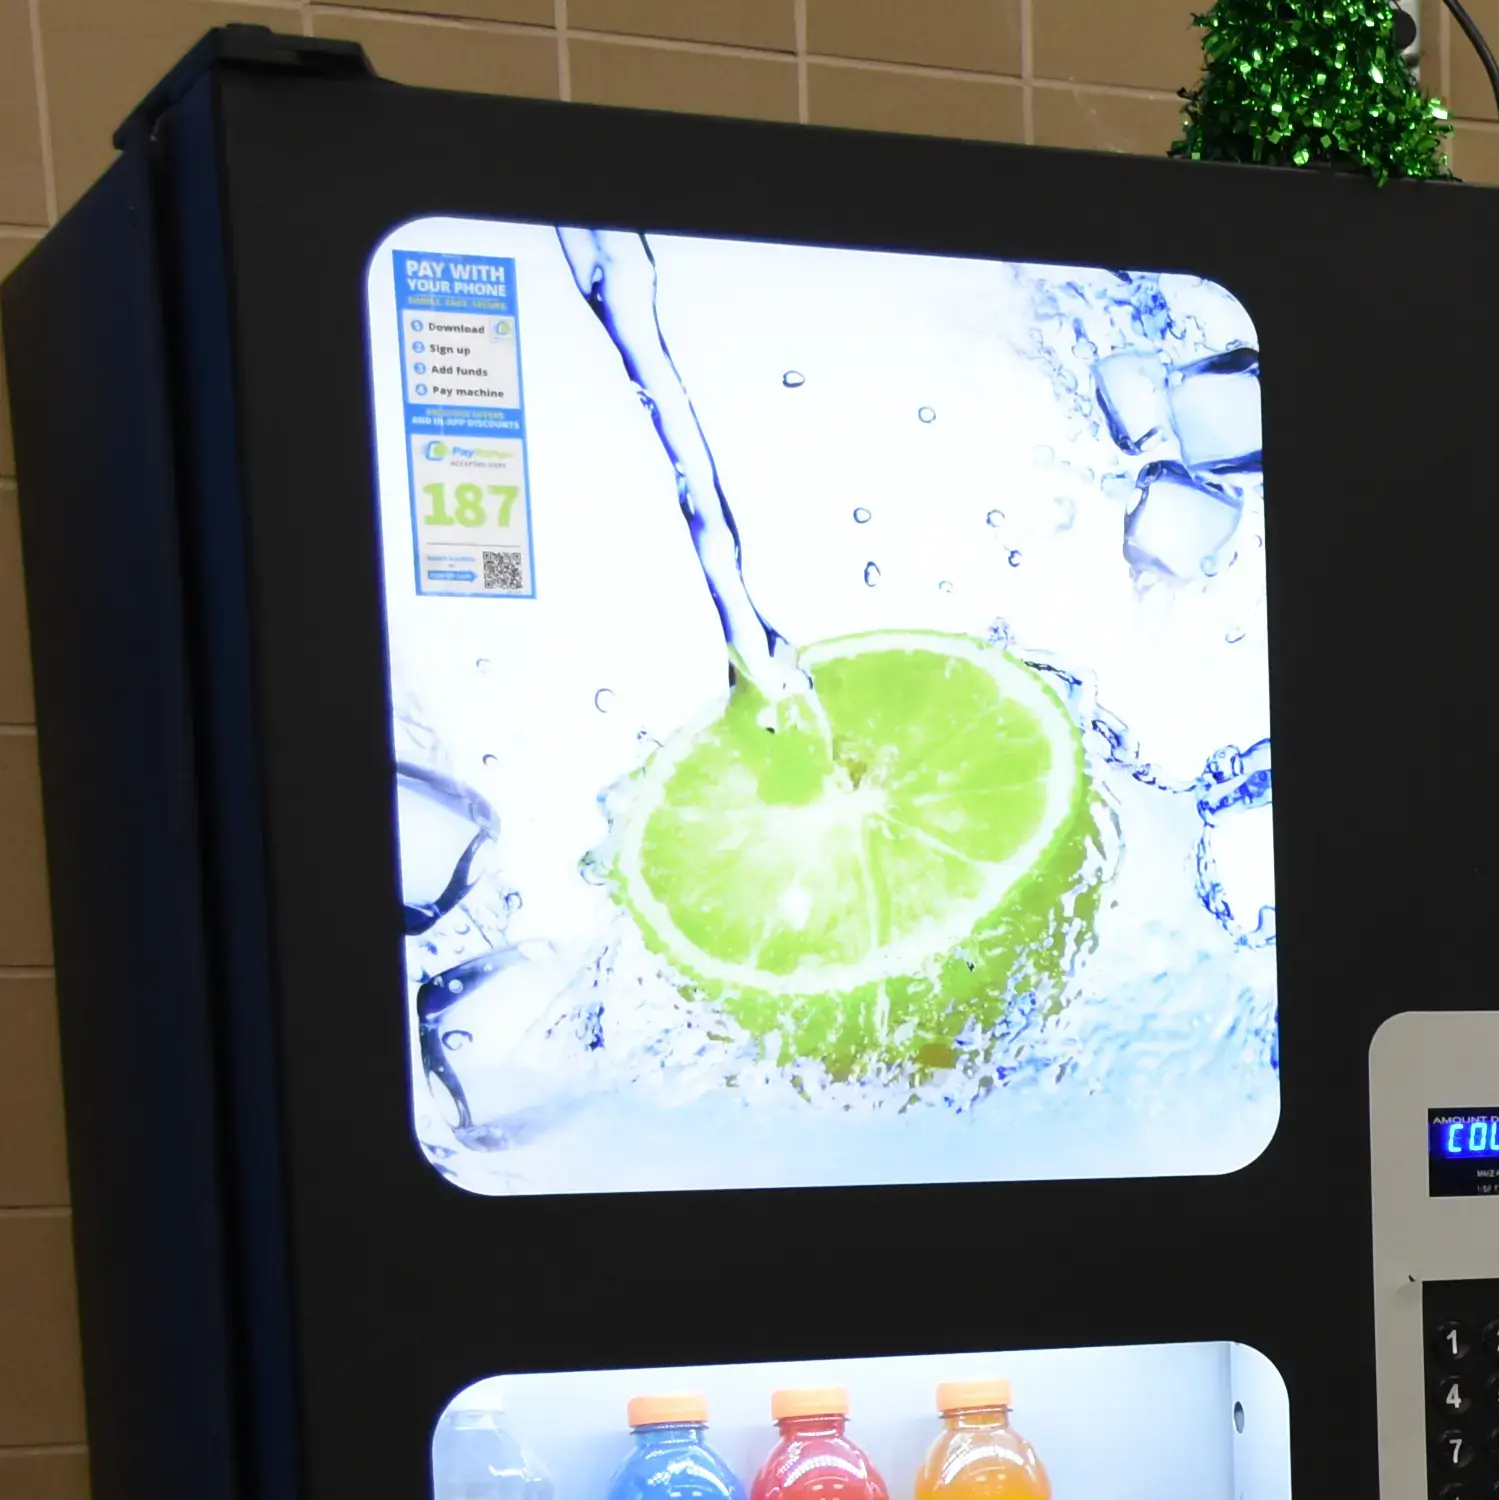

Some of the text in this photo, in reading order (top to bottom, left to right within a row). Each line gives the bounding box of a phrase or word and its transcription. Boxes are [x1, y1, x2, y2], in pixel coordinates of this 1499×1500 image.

[405, 260, 505, 282] PAY WITH
[407, 278, 507, 297] YOUR PHONE
[428, 322, 485, 334] Download
[429, 344, 471, 356] Sign up
[431, 365, 489, 377] Add funds
[432, 386, 505, 398] Pay machine
[423, 482, 520, 528] 187
[1432, 1115, 1488, 1125] AMOUNT
[1446, 1329, 1458, 1355] 1
[1446, 1383, 1462, 1409] 4
[1449, 1438, 1463, 1464] 7
